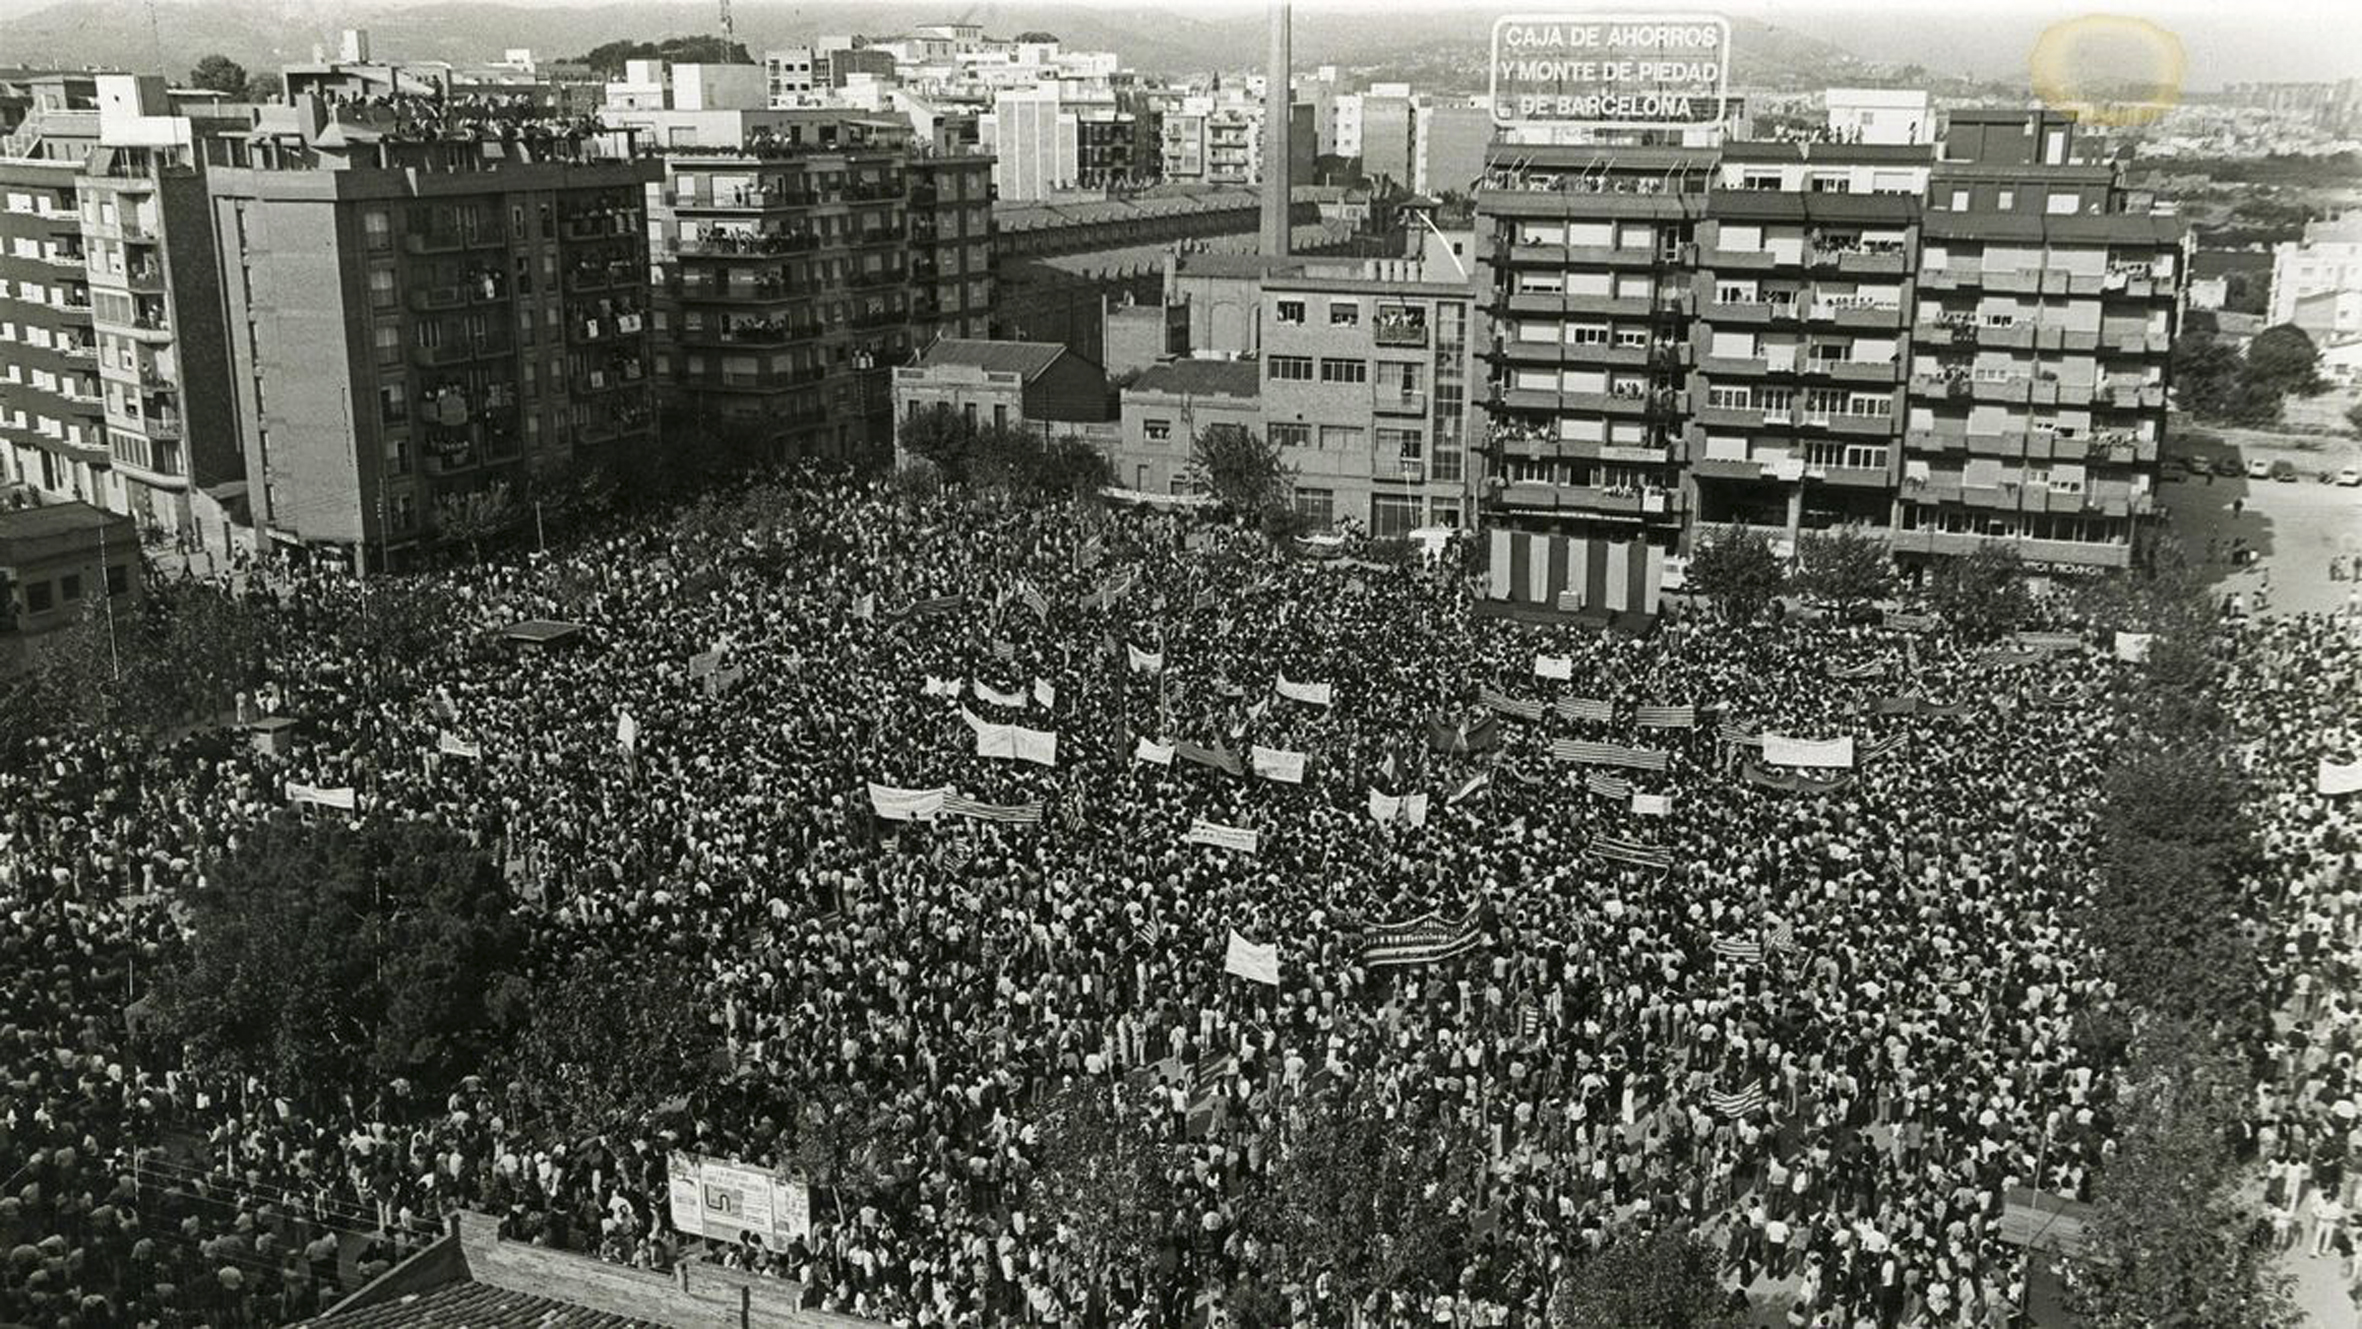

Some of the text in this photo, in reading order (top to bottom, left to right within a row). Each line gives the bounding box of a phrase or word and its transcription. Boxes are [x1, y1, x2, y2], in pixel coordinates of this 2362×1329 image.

[1506, 26, 1718, 47] CAJA DE AHORROS
[1501, 61, 1719, 82] Y MONTE DE PIEDAD
[1520, 95, 1693, 117] DE BARCELONA
